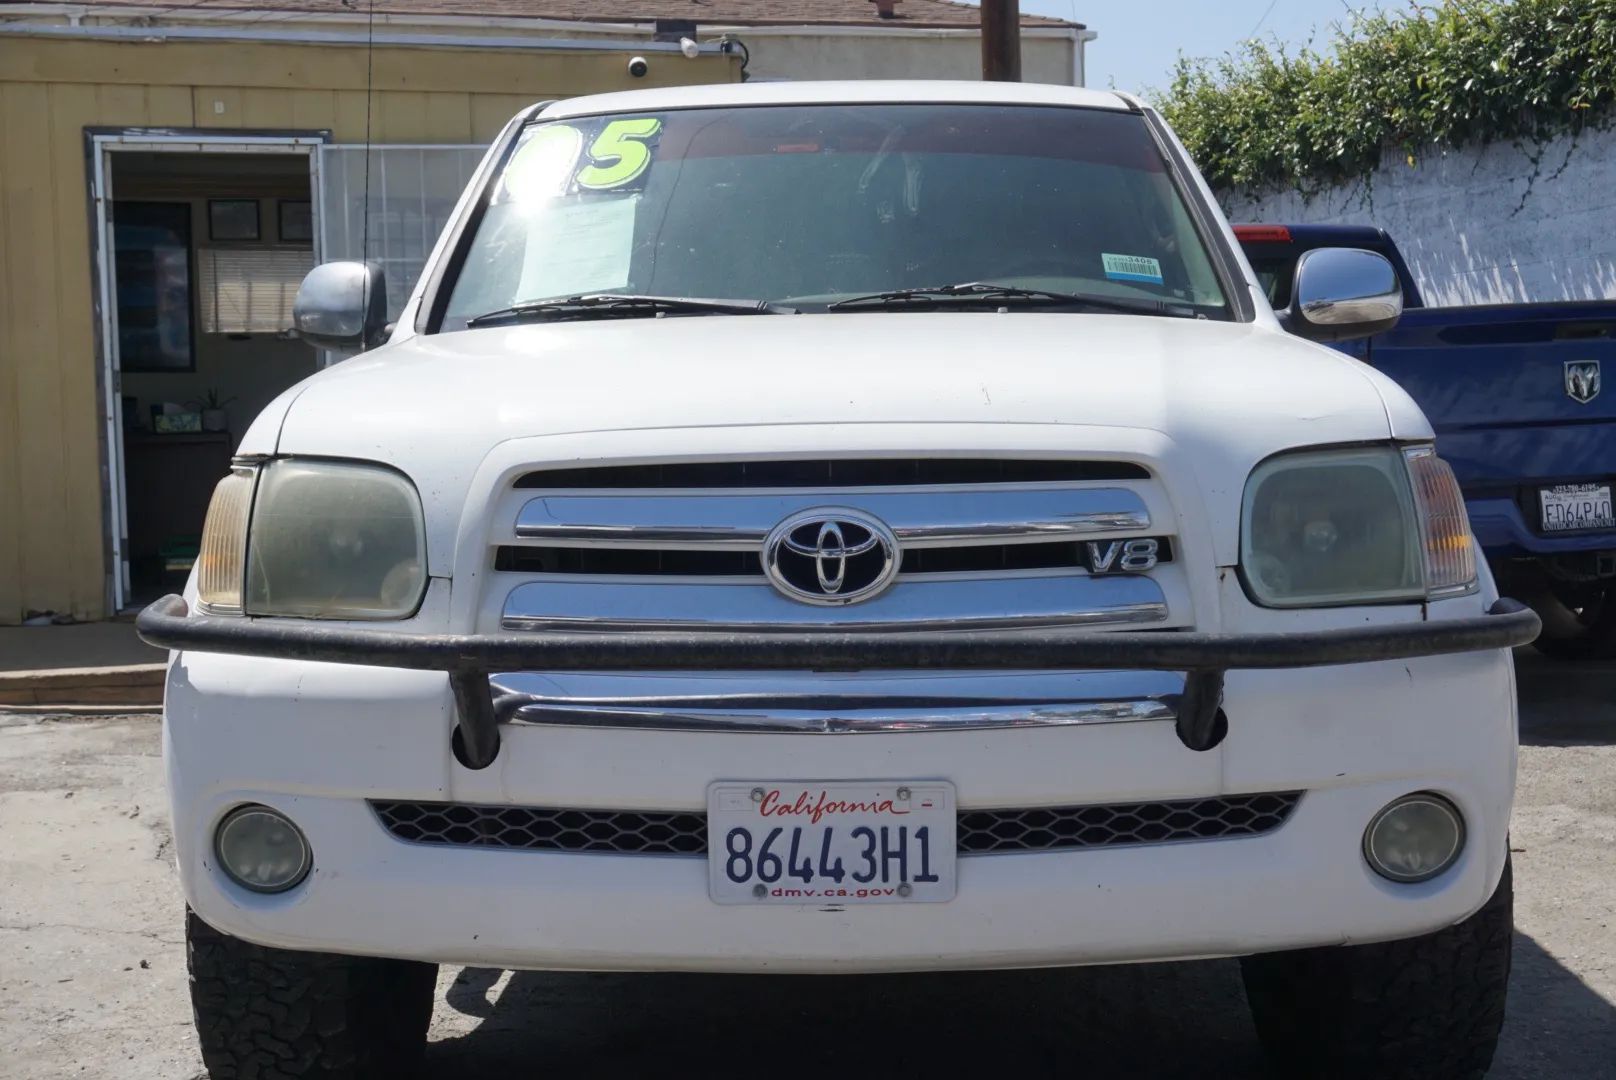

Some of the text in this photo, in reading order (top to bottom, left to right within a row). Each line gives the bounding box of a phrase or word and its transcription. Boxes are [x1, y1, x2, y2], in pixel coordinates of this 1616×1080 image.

[1087, 539, 1158, 573] V8
[760, 790, 910, 824] California
[726, 826, 939, 883] 86443H1
[771, 887, 894, 897] dmv.ca.gov
